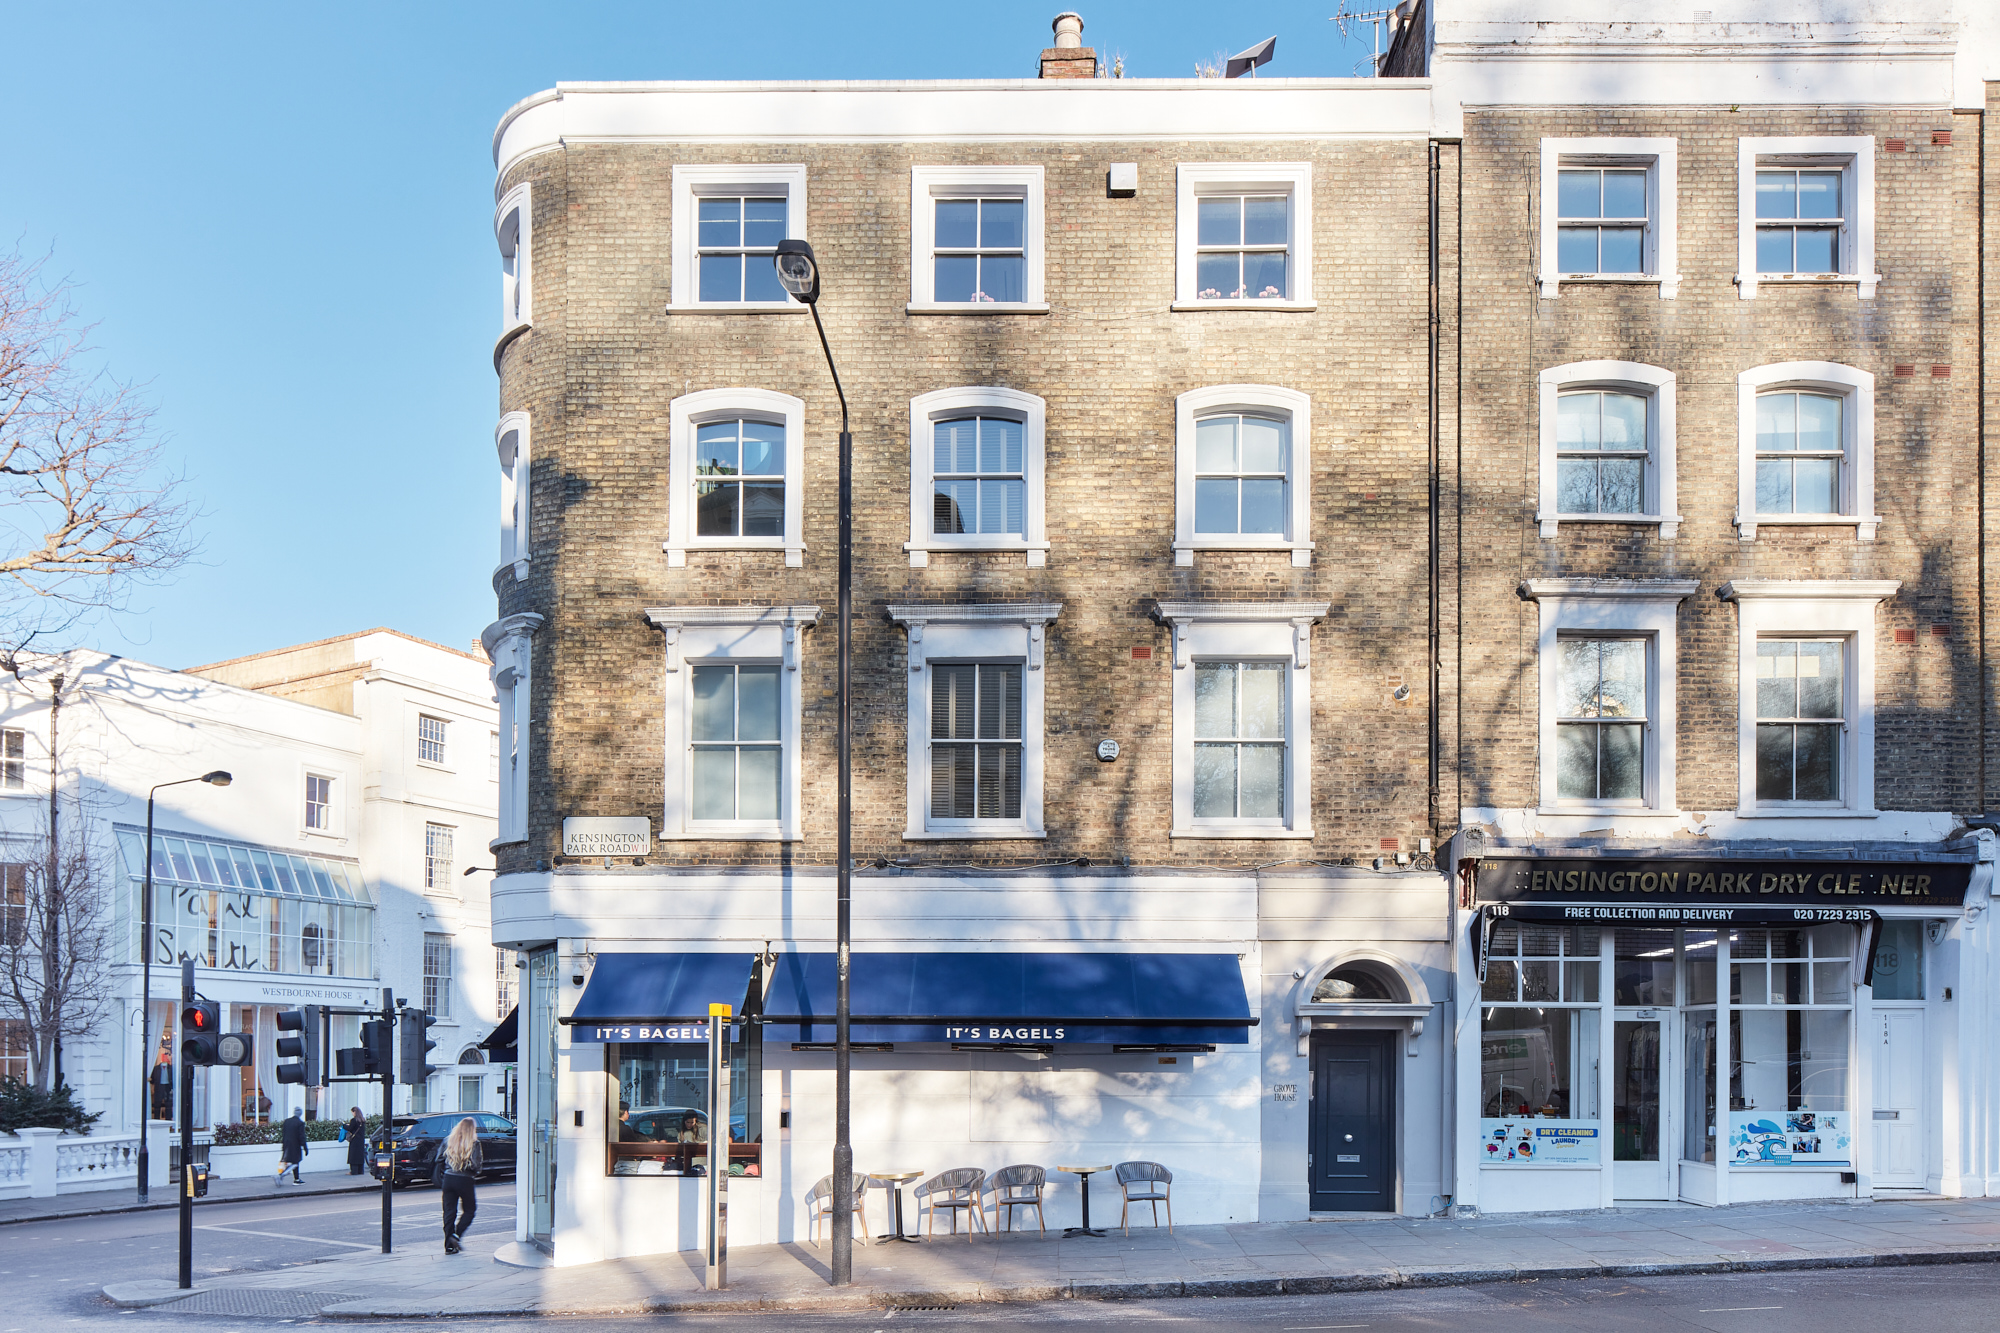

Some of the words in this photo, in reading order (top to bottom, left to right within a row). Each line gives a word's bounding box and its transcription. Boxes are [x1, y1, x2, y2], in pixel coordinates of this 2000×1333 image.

[571, 834, 645, 842] KENSINGTON
[567, 844, 595, 853] PARK
[1531, 871, 1679, 893] ENSINGTON
[1686, 872, 1754, 893] PARK
[1760, 873, 1812, 894] DRY
[1817, 874, 1932, 895] CLENER
[1492, 906, 1509, 916] 118
[1565, 908, 1591, 917] FREE
[1594, 908, 1656, 919] COLLECTION
[1658, 909, 1680, 919] AND
[1683, 910, 1734, 920] DELIVERY
[1794, 910, 1814, 920] 020
[1816, 910, 1843, 920] 7229
[1846, 910, 1872, 920] 2915
[1875, 953, 1898, 968] 118
[262, 988, 323, 998] WESTBOURNE
[324, 990, 352, 999] HOUSE
[596, 1028, 631, 1039] IT'S
[946, 1028, 980, 1039] IT'S
[990, 1028, 1065, 1039] BAGELS
[1274, 1084, 1297, 1093] GROVE
